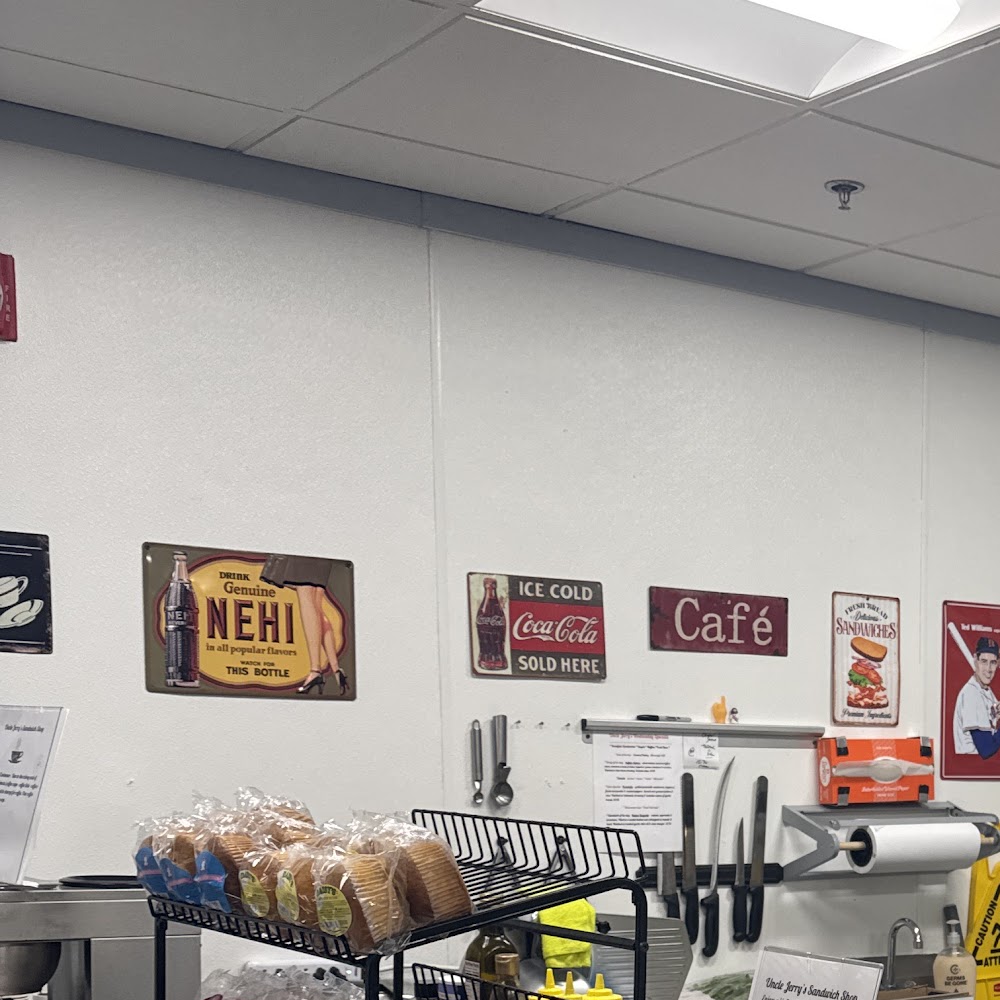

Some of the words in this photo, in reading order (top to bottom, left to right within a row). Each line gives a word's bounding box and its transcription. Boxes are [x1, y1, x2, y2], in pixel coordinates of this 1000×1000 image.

[224, 581, 276, 598] Genuine
[519, 581, 543, 597] ICE
[550, 583, 593, 601] COLD
[206, 597, 294, 644] NEHI
[513, 612, 598, 644] Coca-Cola
[675, 597, 772, 646] Café
[836, 617, 896, 639] SANDWICHES
[206, 643, 214, 651] in
[216, 643, 228, 653] all
[230, 645, 265, 656] popular
[266, 646, 297, 656] flavors
[226, 666, 248, 676] THIS
[254, 667, 289, 677] BOTTLE
[518, 656, 556, 672] SOLD
[561, 658, 600, 674] HERE
[976, 900, 998, 947] CAUTION
[766, 977, 784, 990] Uncle
[784, 981, 807, 996] Jerry's
[808, 985, 840, 1000] Sandwich
